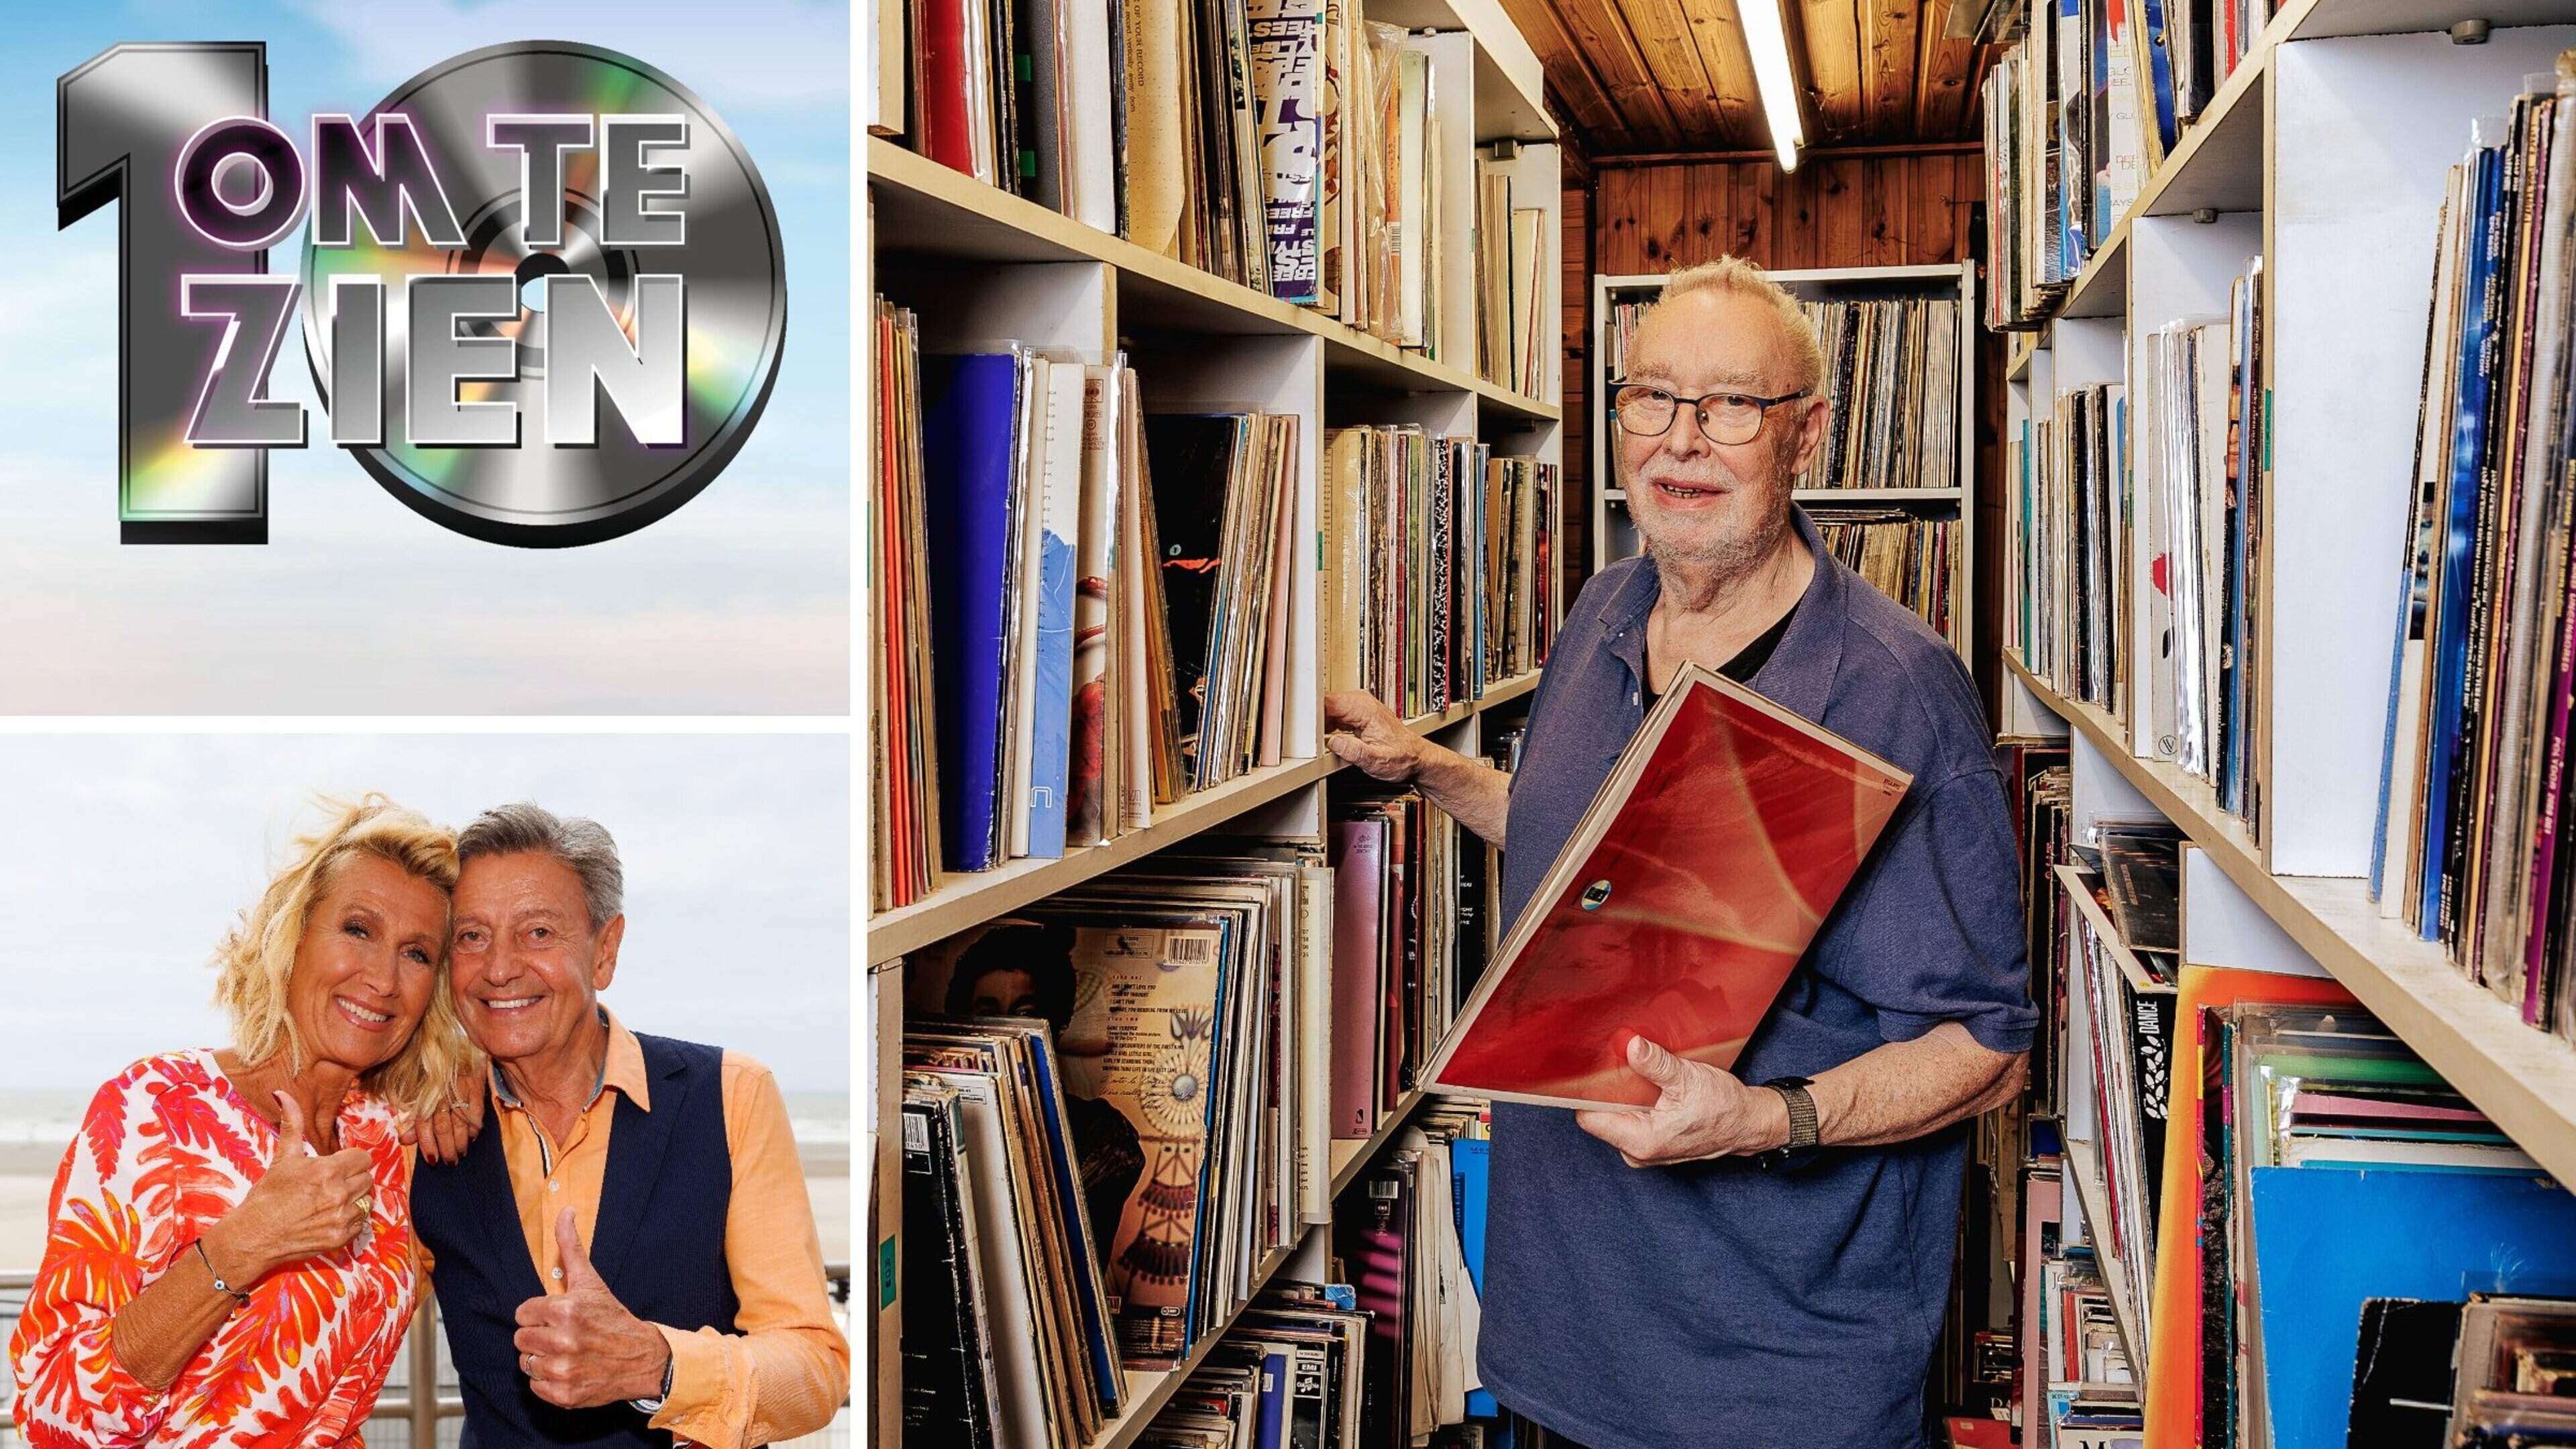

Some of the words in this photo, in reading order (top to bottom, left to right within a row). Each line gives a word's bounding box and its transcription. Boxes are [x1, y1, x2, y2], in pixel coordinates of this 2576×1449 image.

[1134, 5, 1140, 18] OF
[1126, 38, 1134, 69] vertically
[1136, 48, 1144, 87] RECORD
[2488, 272, 2496, 320] JACKSONS
[2561, 593, 2576, 672] UNCENSORED
[2137, 1000, 2159, 1034] DANCE
